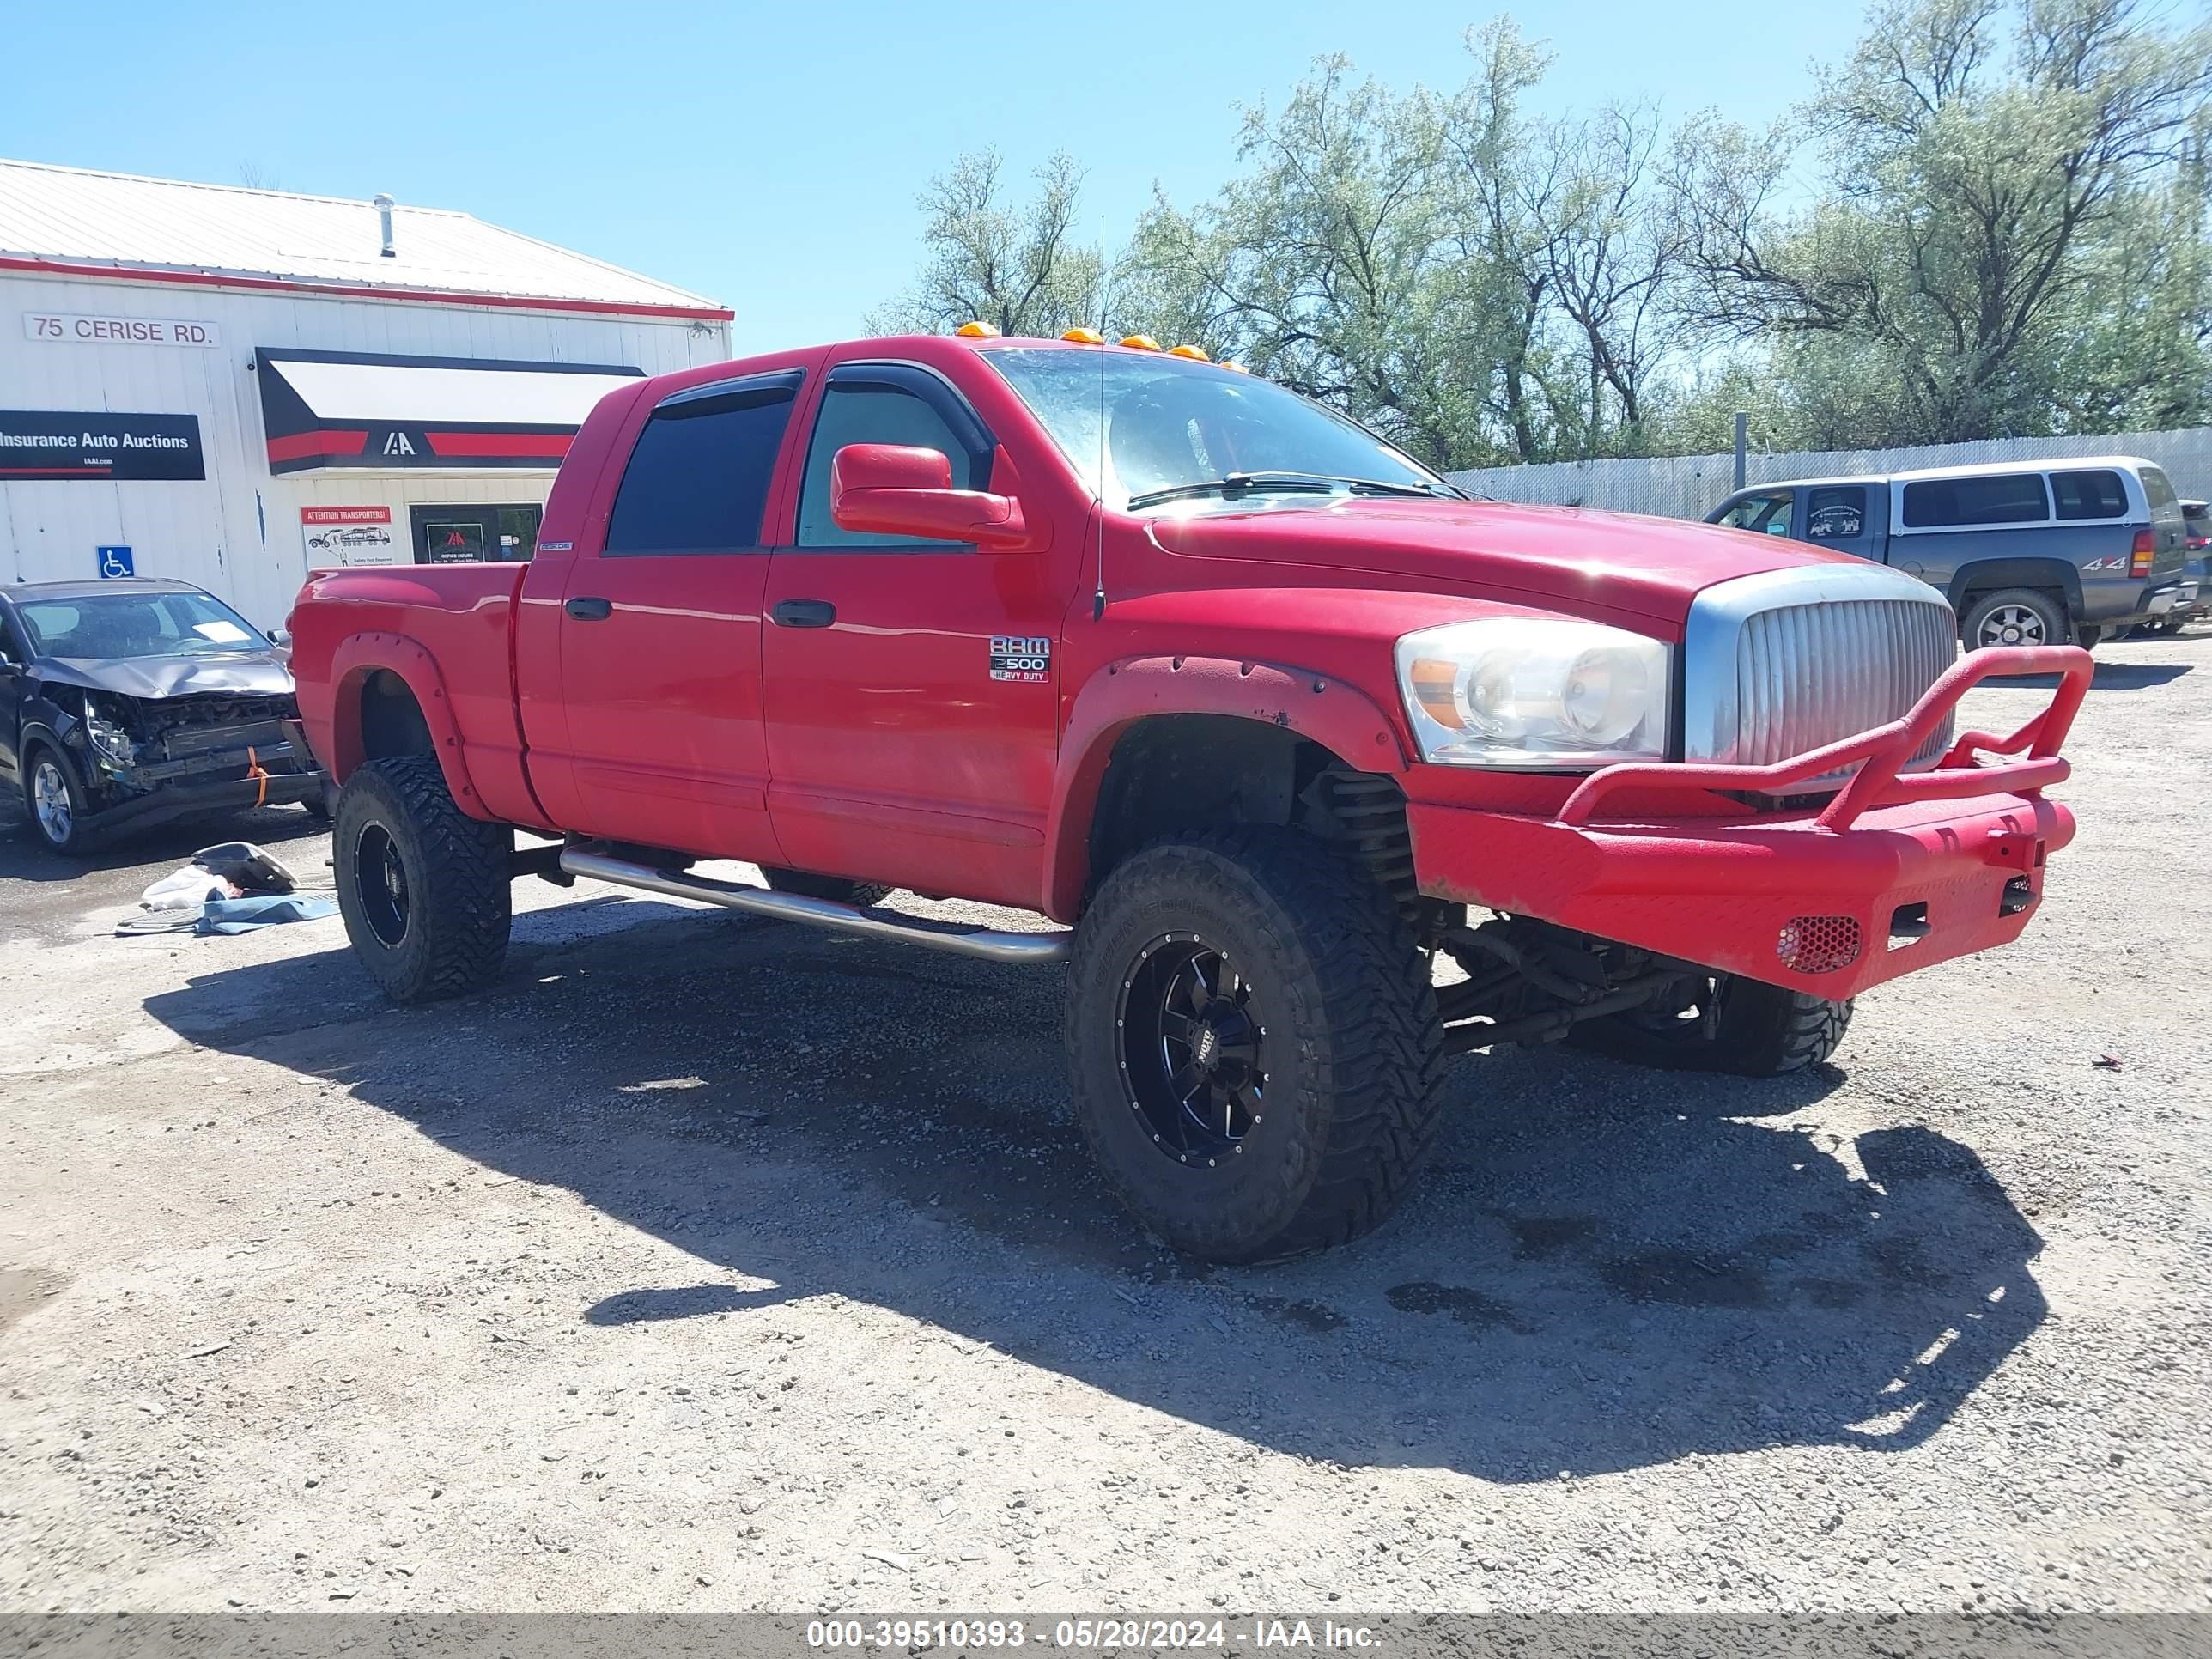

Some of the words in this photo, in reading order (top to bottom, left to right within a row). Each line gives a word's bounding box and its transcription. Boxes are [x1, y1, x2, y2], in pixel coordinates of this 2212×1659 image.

[33, 318, 64, 337] 75
[75, 319, 164, 342] CERISE
[173, 325, 214, 343] RD.
[0, 431, 77, 447] Insurance
[82, 432, 118, 448] Auto
[123, 433, 189, 449] Auctions
[307, 511, 338, 520] ATTENTION
[340, 510, 386, 520] TRANSPORTERS!
[989, 636, 1050, 654] RAM
[994, 658, 1045, 671] 2500
[996, 672, 1021, 680] HEAVY
[1024, 672, 1044, 681] DUTY
